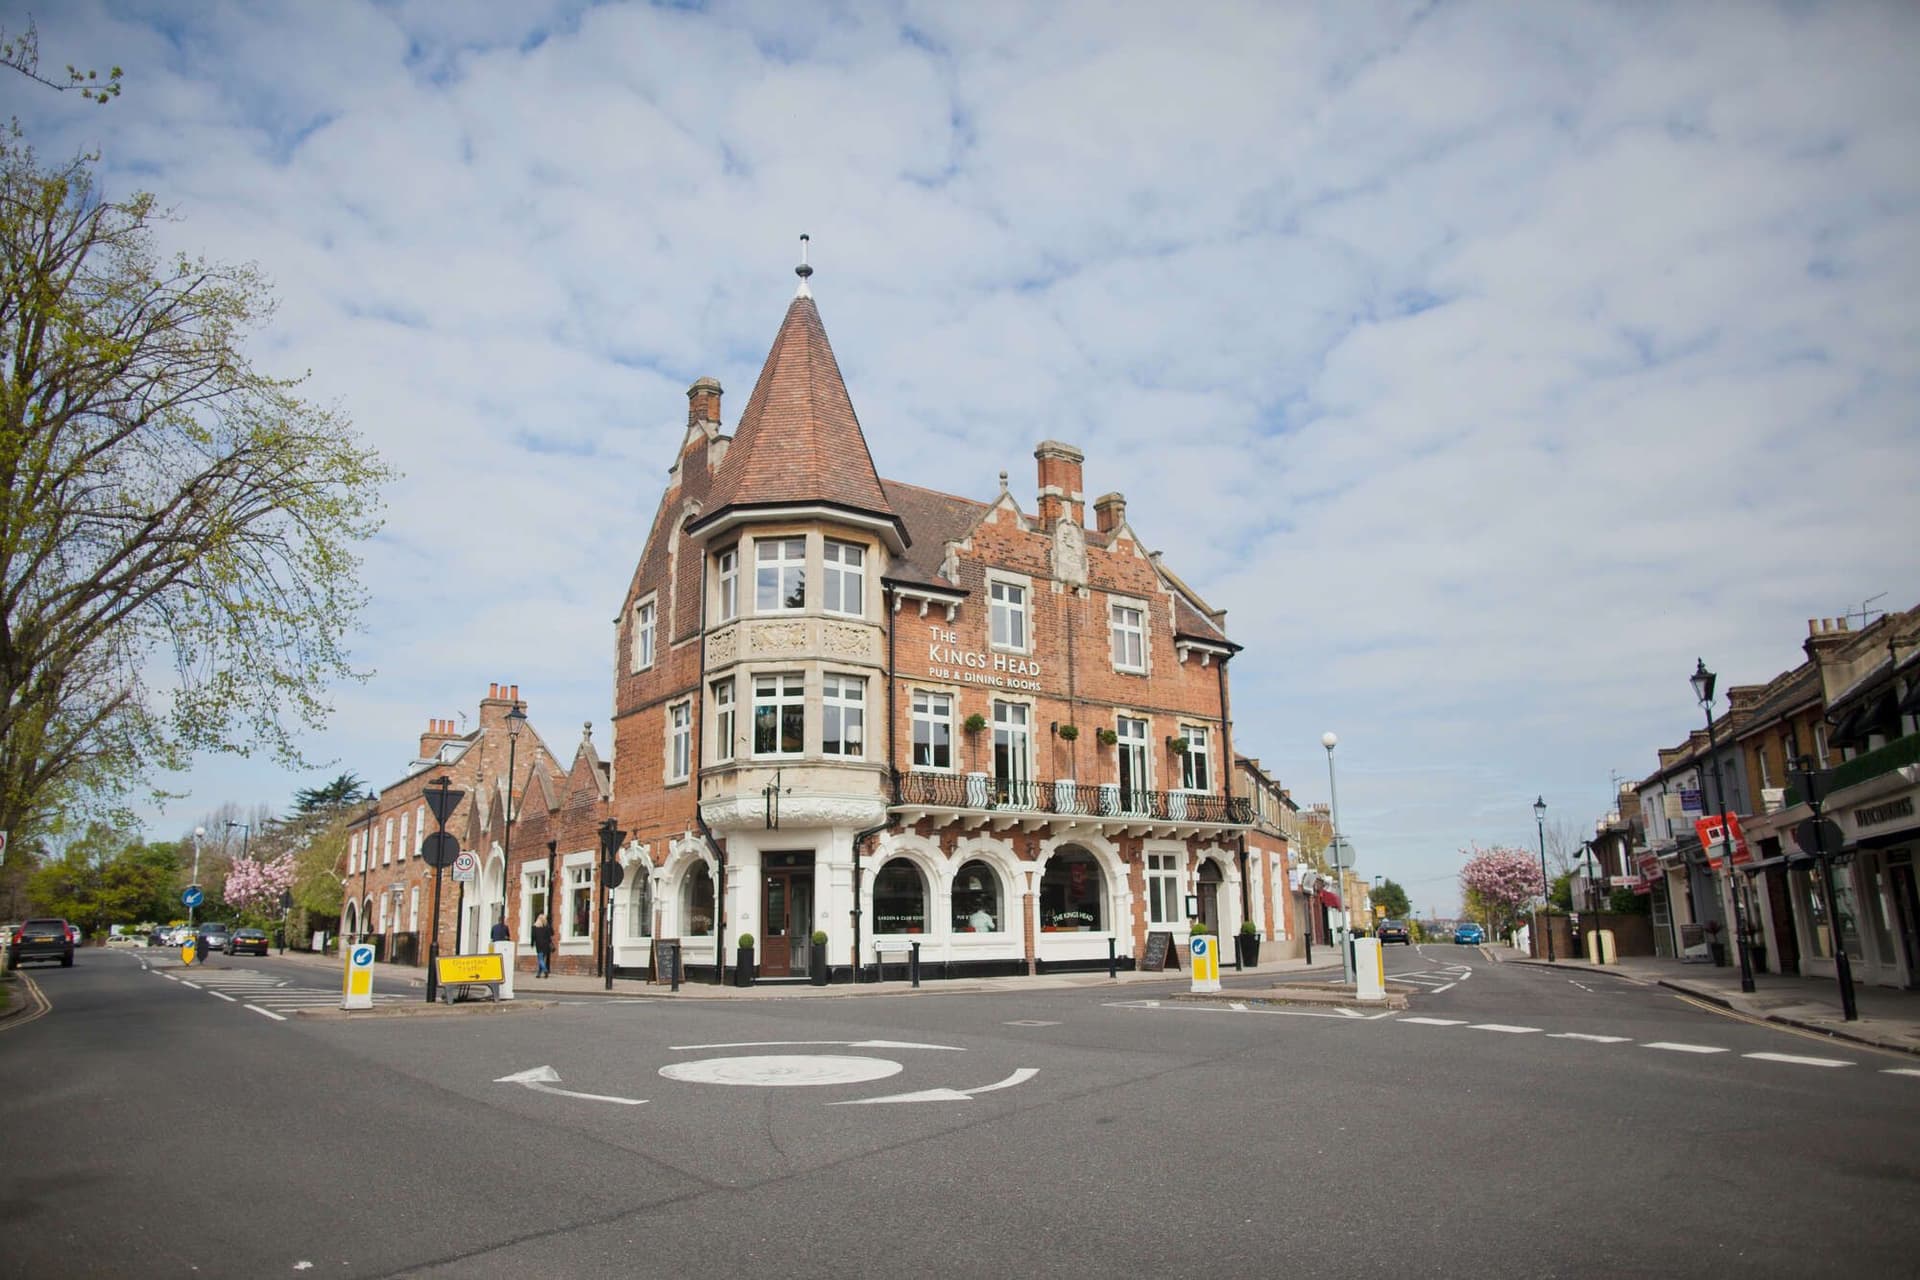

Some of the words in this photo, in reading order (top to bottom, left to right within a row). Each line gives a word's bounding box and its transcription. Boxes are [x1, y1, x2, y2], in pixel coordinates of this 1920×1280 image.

[929, 627, 957, 643] THE
[929, 645, 986, 669] KINGS
[994, 654, 1040, 676] HEAD
[929, 667, 949, 679] PUB
[953, 671, 961, 681] &
[964, 672, 1004, 687] DINING
[1006, 679, 1041, 692] ROOMS
[459, 858, 471, 866] 30
[1063, 911, 1079, 919] KINGS
[1079, 912, 1094, 922] HEAD
